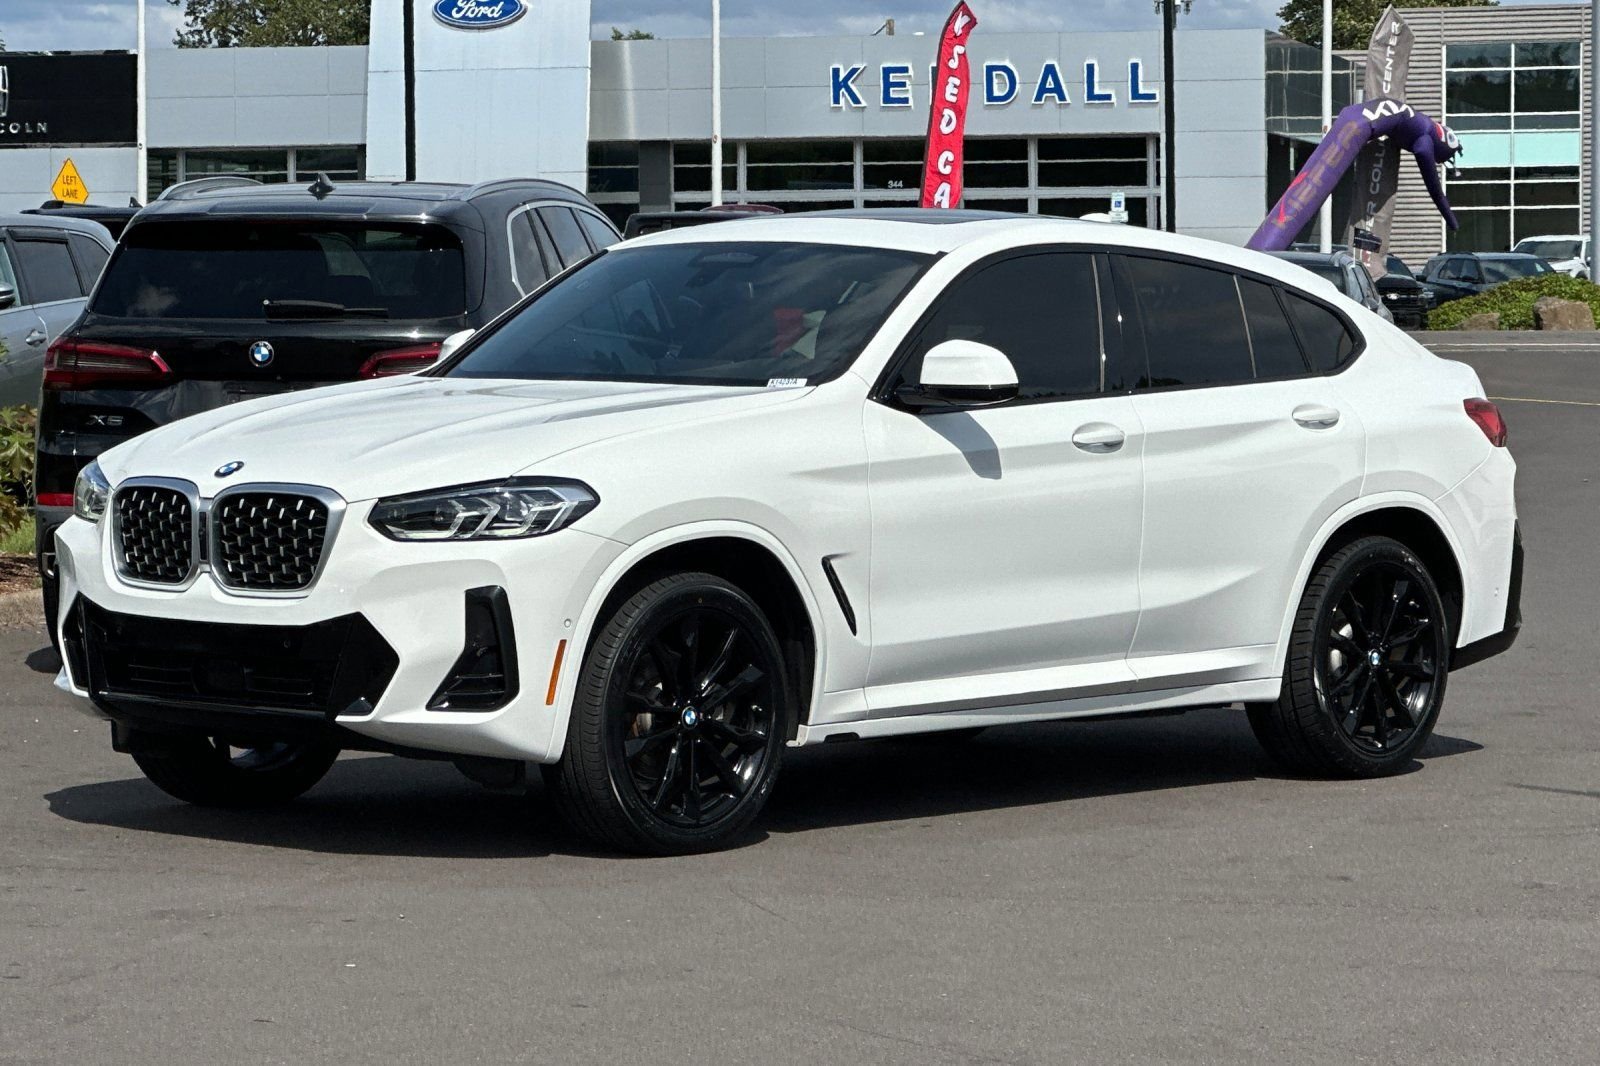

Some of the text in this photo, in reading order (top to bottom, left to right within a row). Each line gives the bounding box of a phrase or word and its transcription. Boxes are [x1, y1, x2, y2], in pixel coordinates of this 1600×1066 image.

[451, 0, 504, 19] Ford
[1382, 21, 1400, 94] CENTER
[830, 60, 1160, 107] KEDALL
[62, 175, 77, 185] LEFT
[888, 180, 903, 188] 344
[62, 189, 78, 199] LANE
